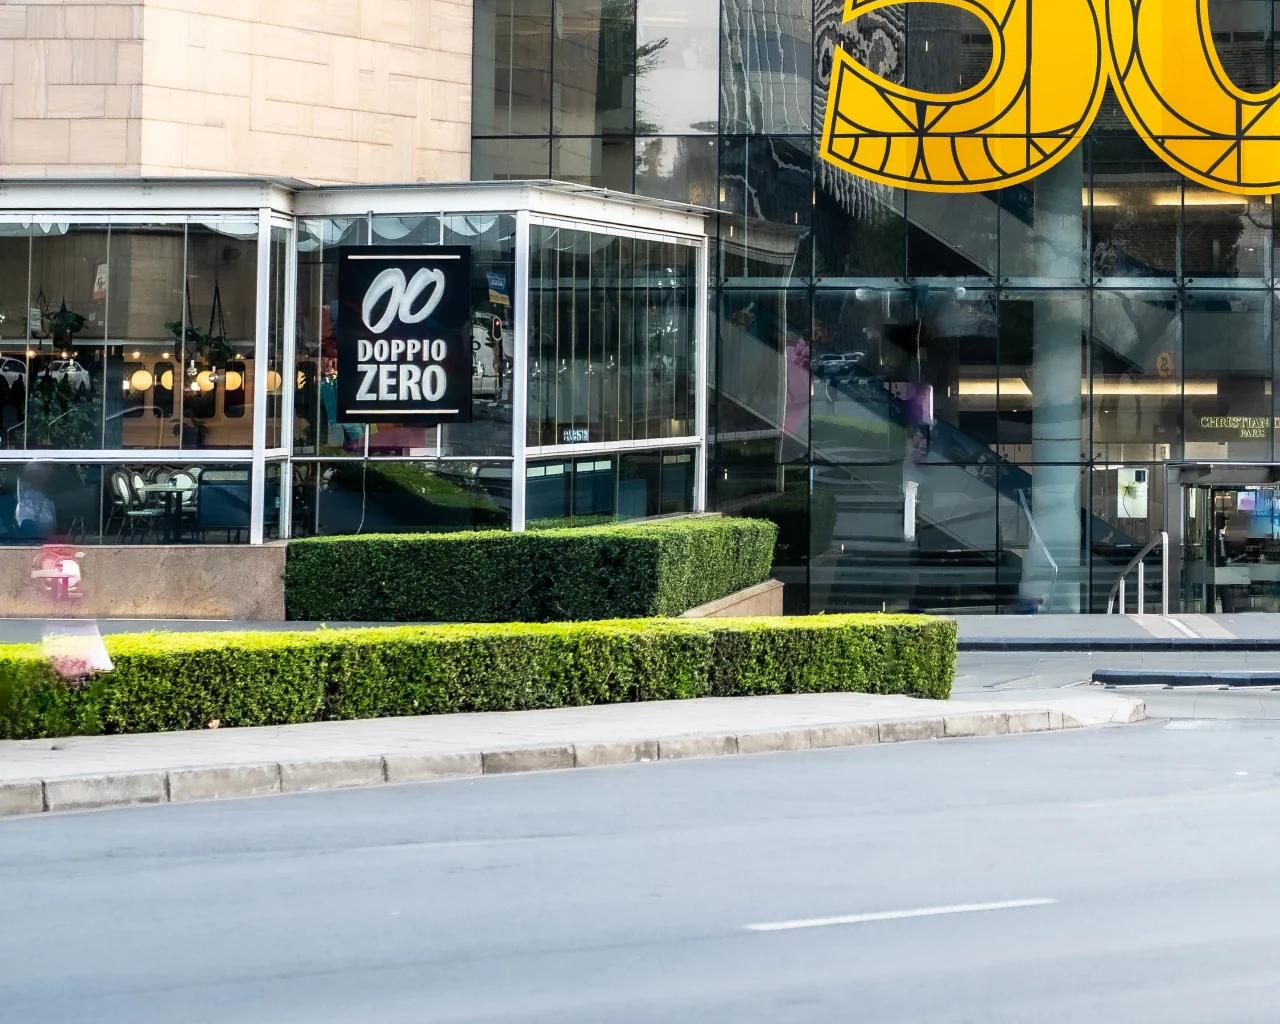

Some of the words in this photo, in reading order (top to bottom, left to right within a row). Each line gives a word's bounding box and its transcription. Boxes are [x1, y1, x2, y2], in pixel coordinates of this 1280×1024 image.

[357, 339, 447, 362] DOPPIO
[356, 364, 447, 401] ZERO
[1200, 417, 1269, 429] CHRISTIAN
